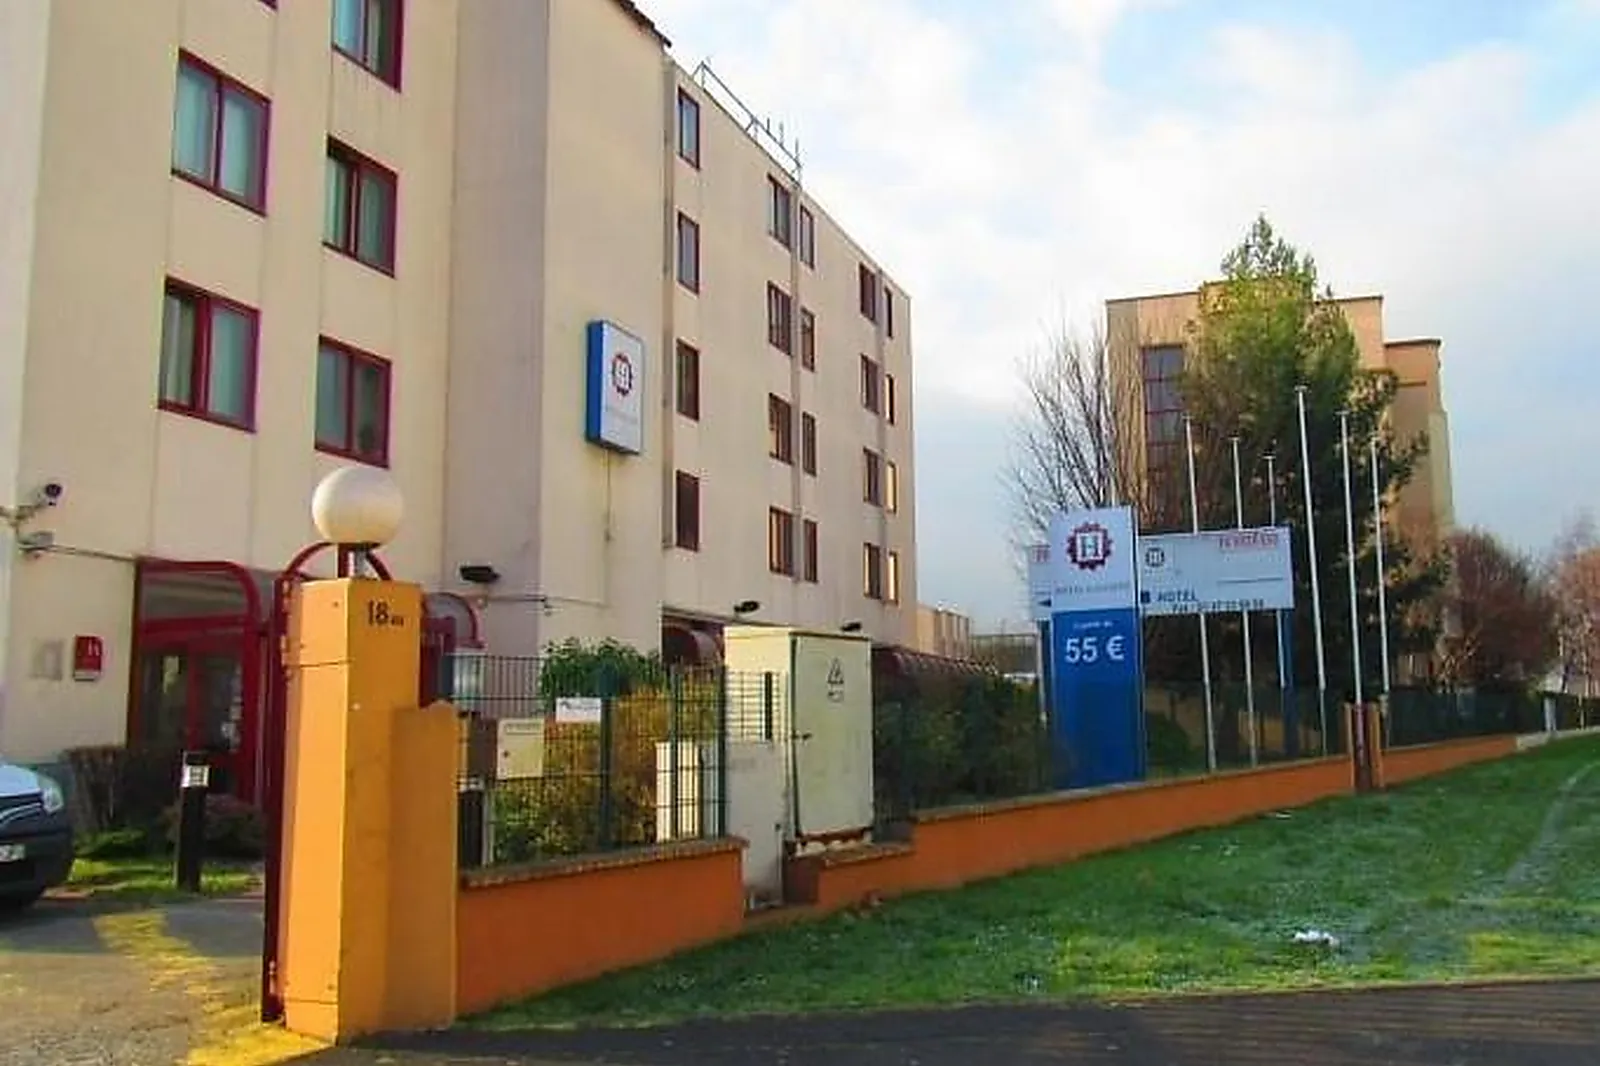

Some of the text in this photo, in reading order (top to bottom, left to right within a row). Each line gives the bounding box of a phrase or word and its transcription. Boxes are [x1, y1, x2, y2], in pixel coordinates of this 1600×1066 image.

[368, 600, 389, 627] 18
[1065, 635, 1125, 662] 55 €
